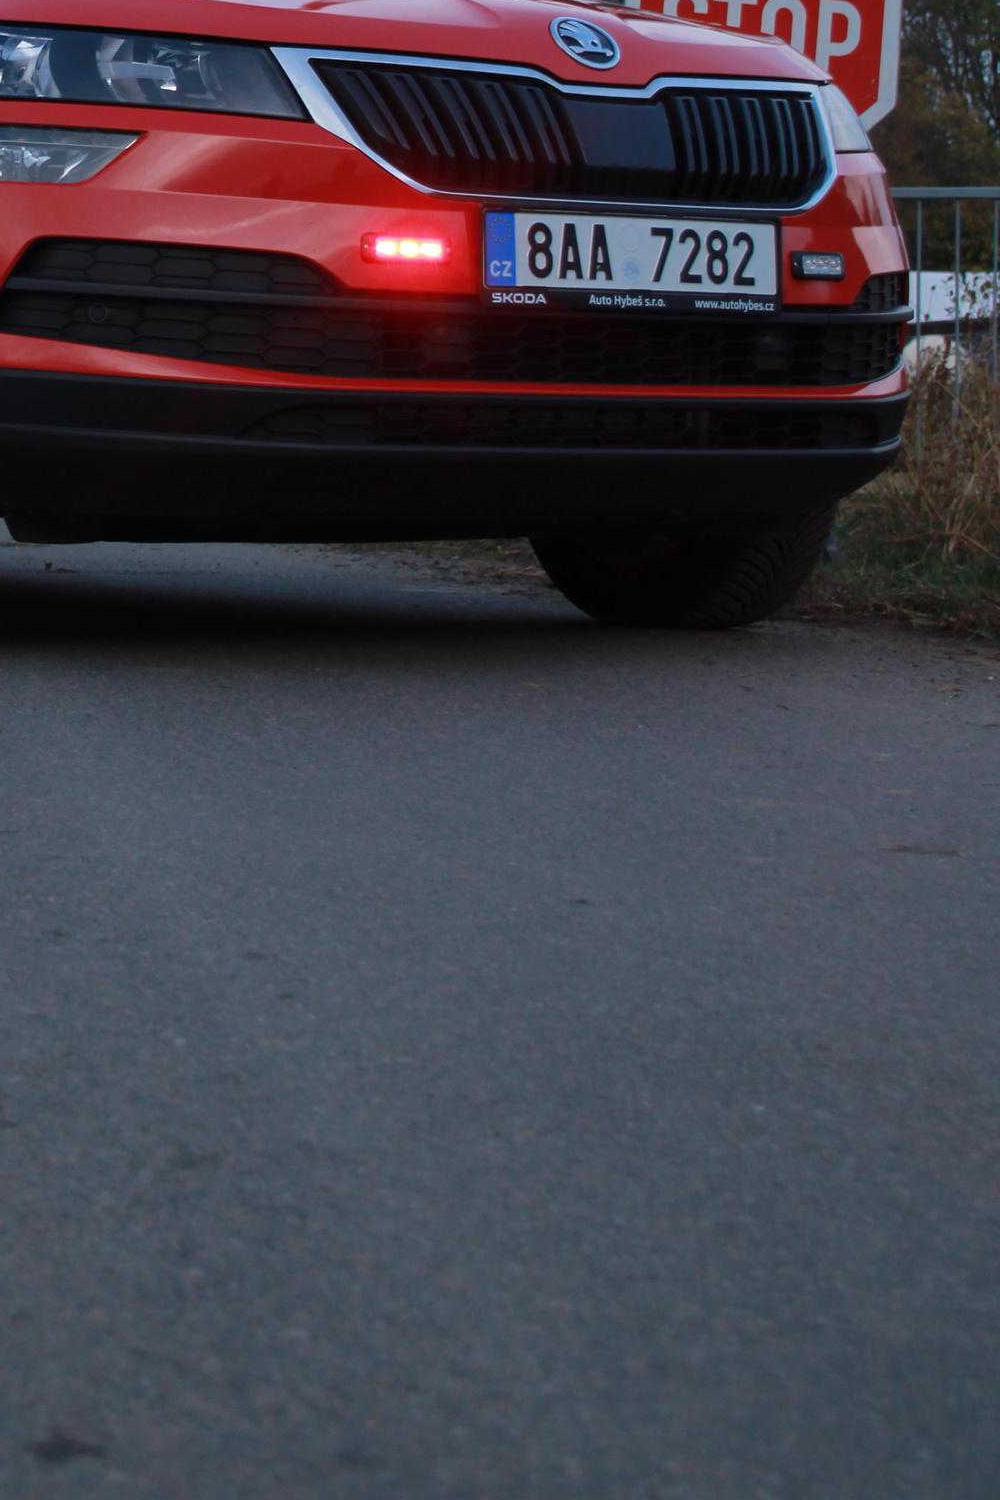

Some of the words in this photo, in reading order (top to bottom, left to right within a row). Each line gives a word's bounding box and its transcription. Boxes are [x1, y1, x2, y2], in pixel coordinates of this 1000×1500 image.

[528, 222, 613, 281] 8AA
[650, 227, 755, 286] 7282
[490, 260, 512, 277] CZ
[589, 294, 611, 305] Auto
[614, 295, 643, 308] Hybeš
[645, 298, 666, 307] s.r.o.
[695, 299, 775, 312] www.autohybes.cz
